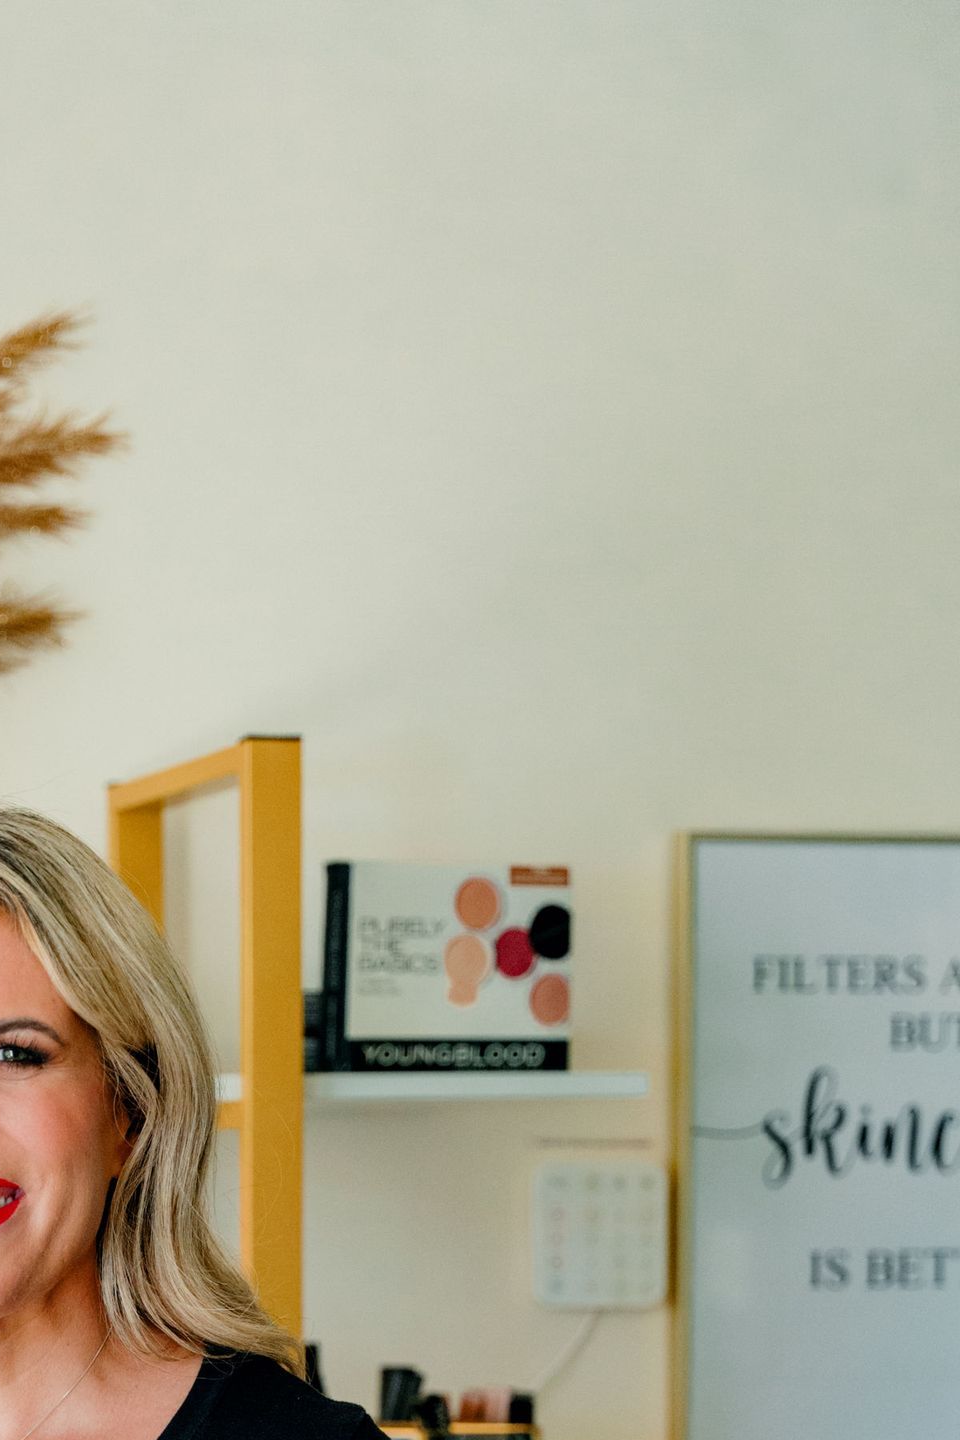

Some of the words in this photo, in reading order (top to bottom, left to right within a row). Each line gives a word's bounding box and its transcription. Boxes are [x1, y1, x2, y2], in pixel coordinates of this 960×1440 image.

[752, 954, 928, 996] FILTERS
[362, 1042, 546, 1069] YOUNGBLOOD
[809, 1248, 851, 1293] IS
[866, 1247, 960, 1293] BET
